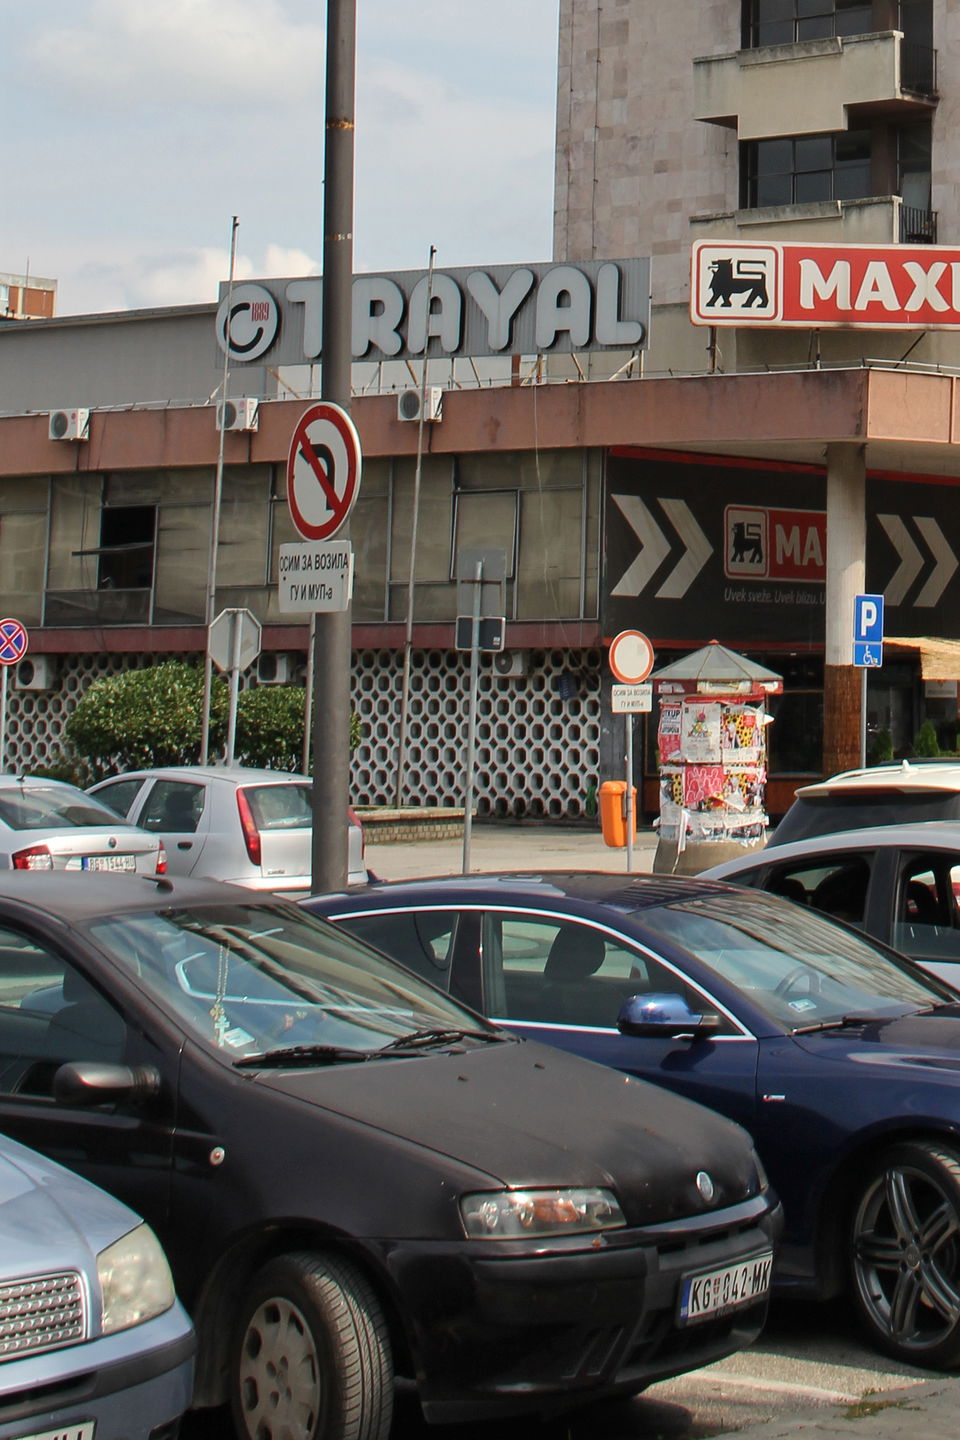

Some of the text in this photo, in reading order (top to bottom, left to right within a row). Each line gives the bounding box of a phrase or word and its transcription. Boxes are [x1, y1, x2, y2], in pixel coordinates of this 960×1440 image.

[252, 303, 270, 321] 1889
[286, 263, 643, 359] TRAYAL
[775, 524, 828, 566] MA
[302, 554, 313, 570] ЗА
[314, 553, 349, 570] ВОЗИЛА
[290, 584, 333, 601] ГУ И МУП-а
[724, 588, 746, 602] Uvek
[861, 601, 877, 637] P
[691, 1278, 711, 1312] KG
